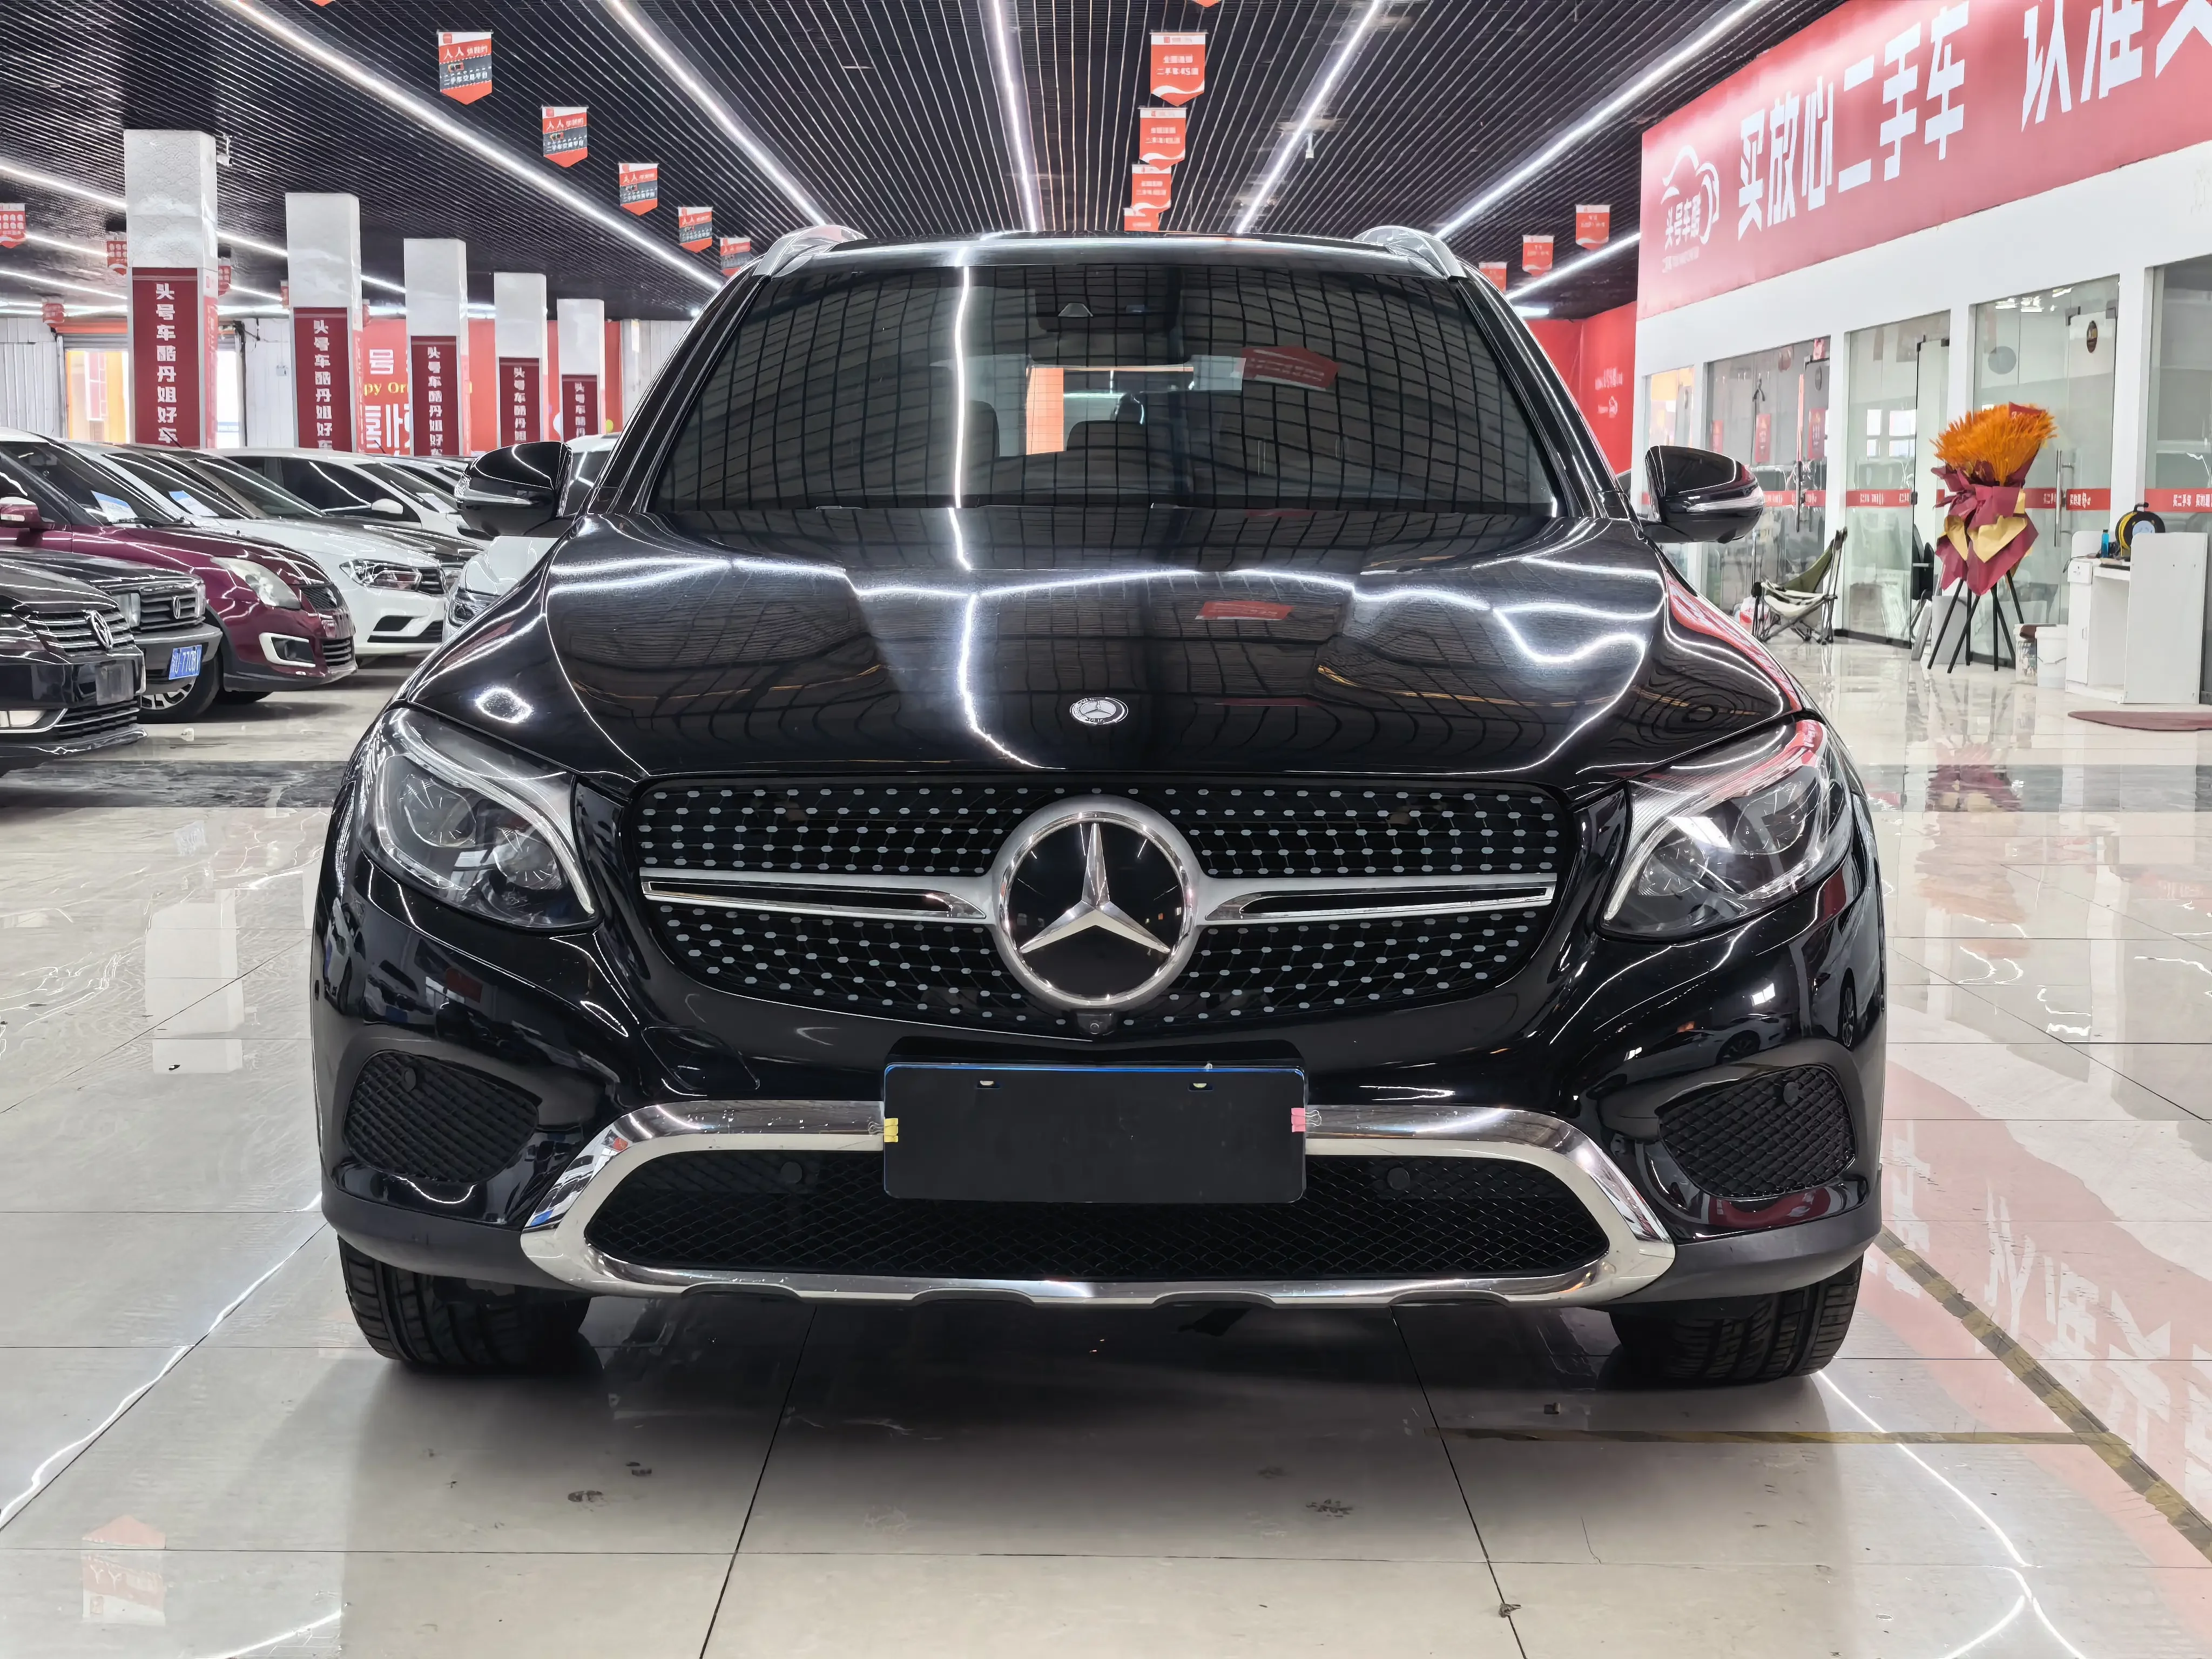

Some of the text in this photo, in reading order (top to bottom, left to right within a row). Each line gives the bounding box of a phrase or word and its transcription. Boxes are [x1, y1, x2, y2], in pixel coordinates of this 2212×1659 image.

[1738, 1, 1969, 241] 买放心二手车
[156, 282, 178, 443] 头号车酷丹姐好车
